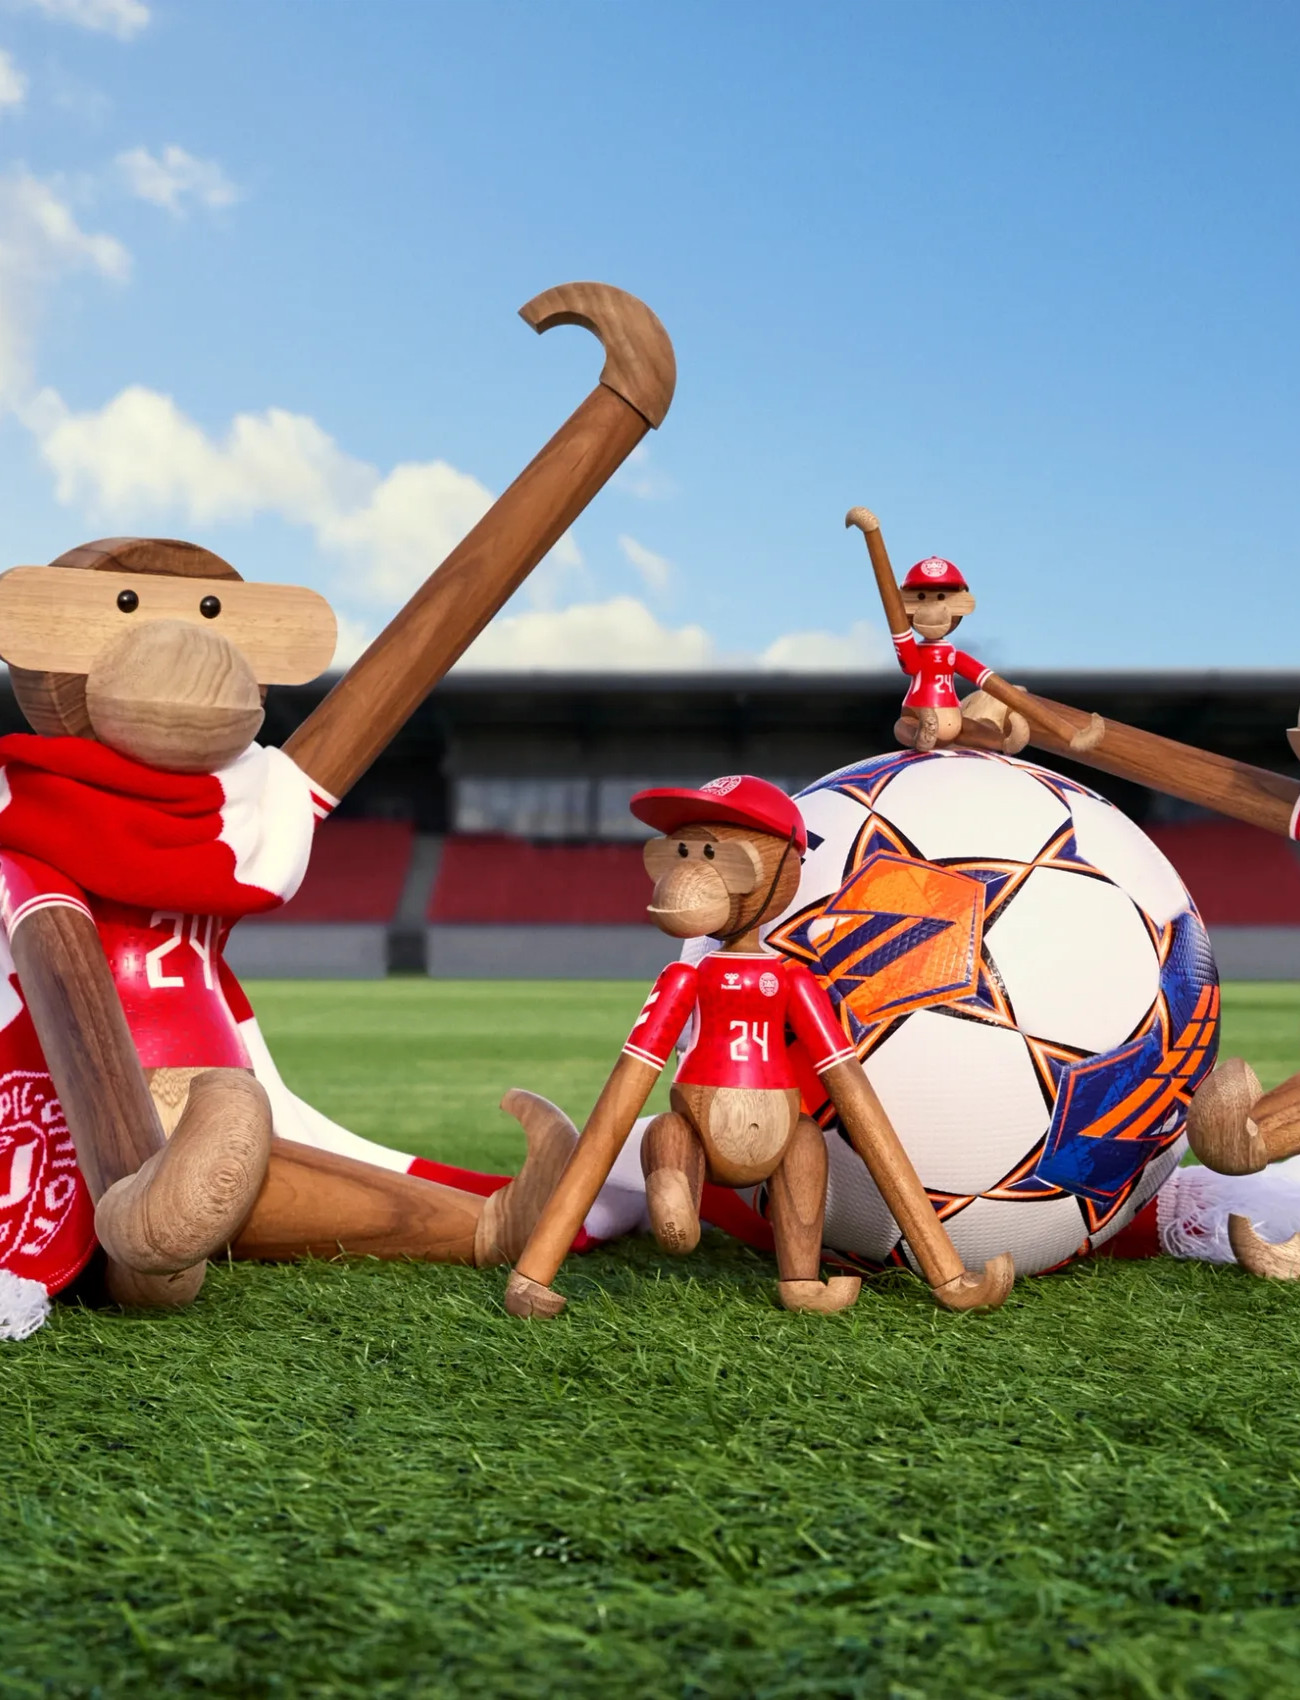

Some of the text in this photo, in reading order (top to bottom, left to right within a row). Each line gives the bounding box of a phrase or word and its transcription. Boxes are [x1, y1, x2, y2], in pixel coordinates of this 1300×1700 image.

[934, 674, 953, 694] 24
[146, 910, 213, 990] 24
[729, 1020, 769, 1062] 24
